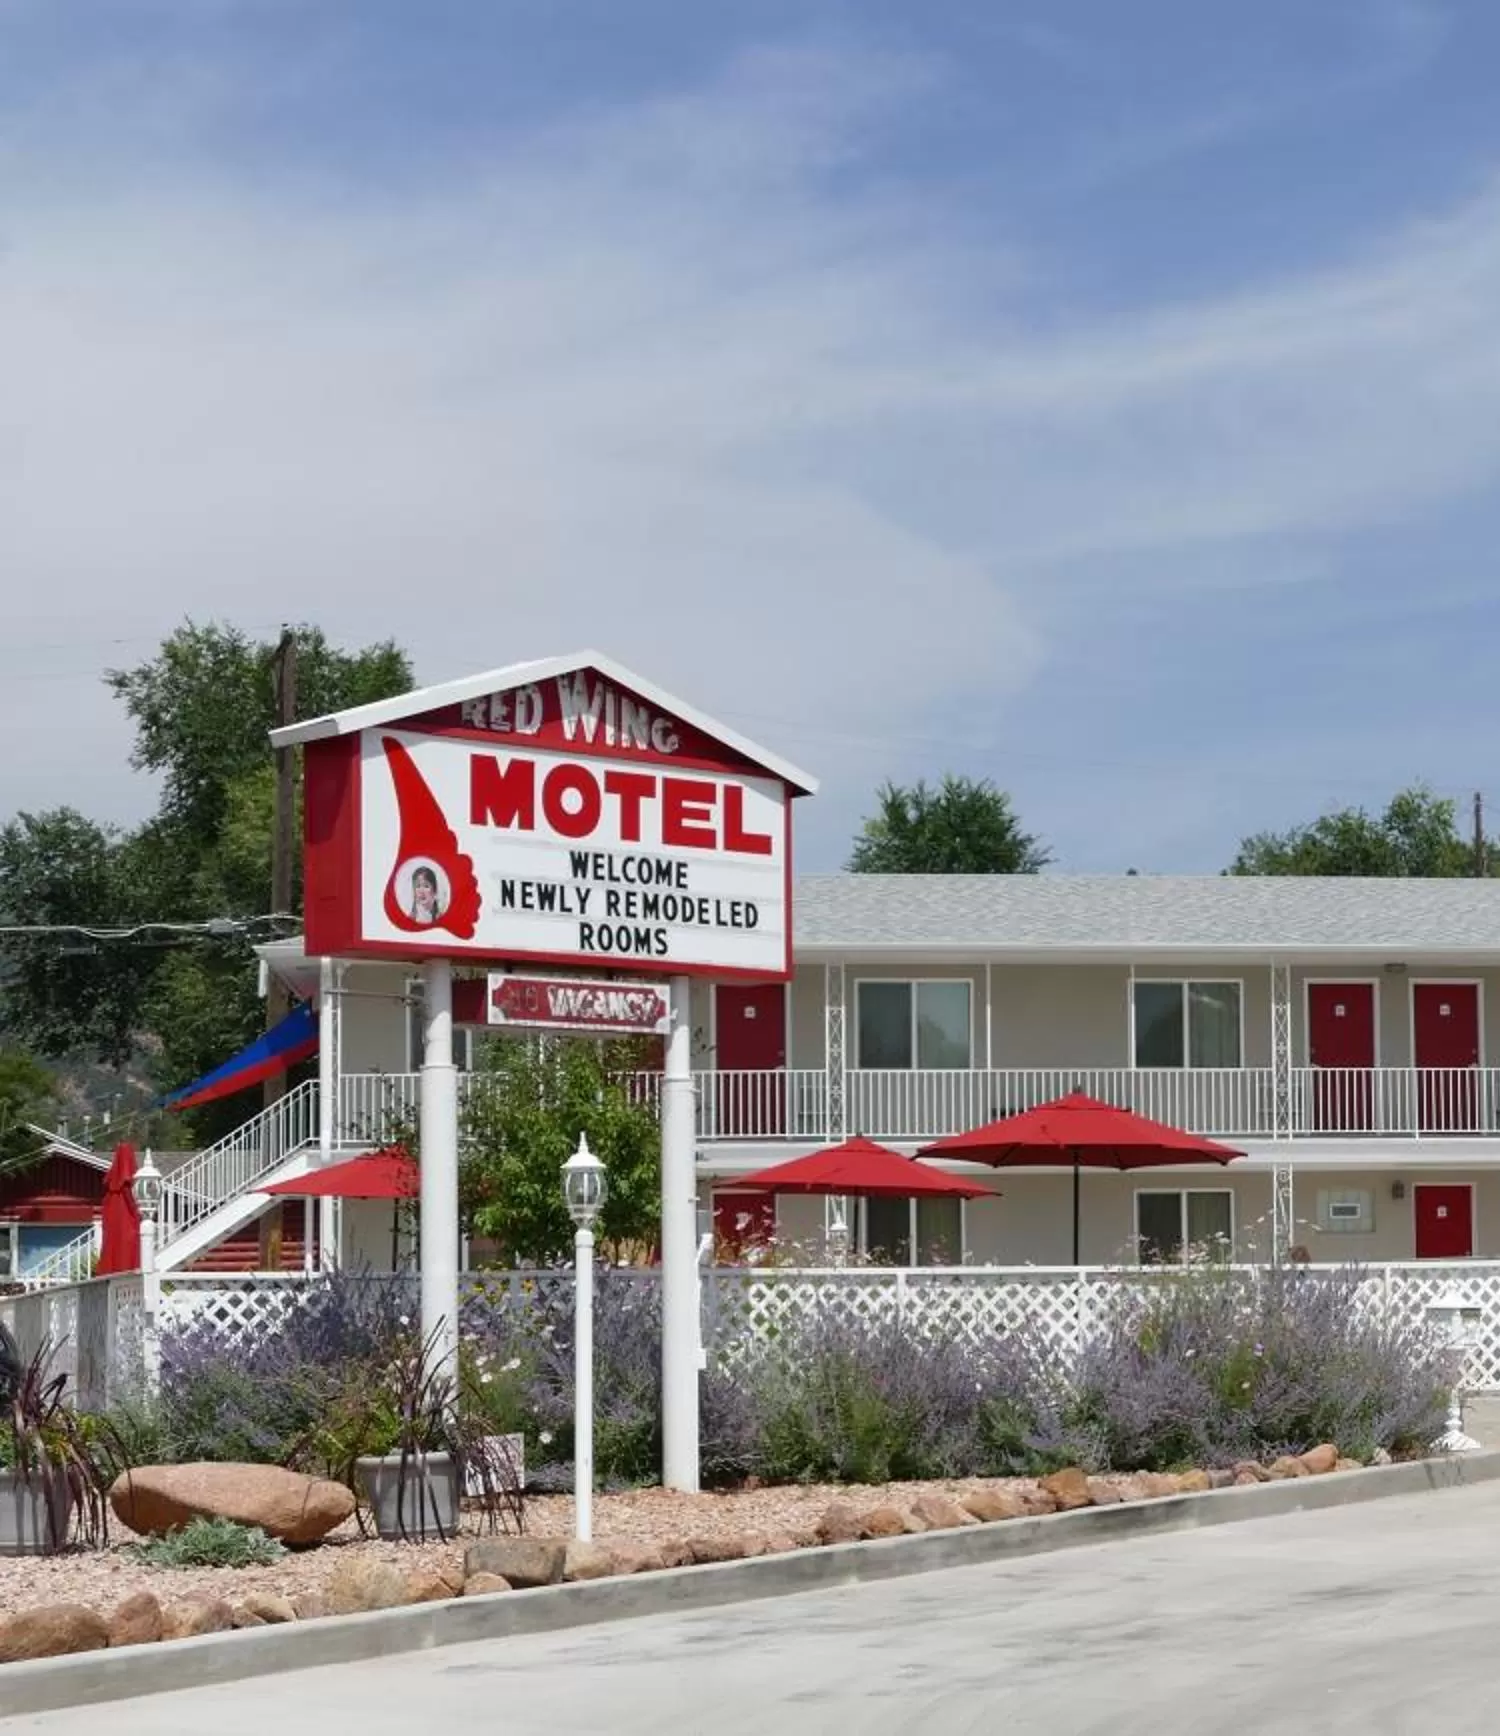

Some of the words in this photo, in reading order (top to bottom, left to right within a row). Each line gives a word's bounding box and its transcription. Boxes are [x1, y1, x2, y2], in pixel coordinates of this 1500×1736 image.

[462, 684, 543, 735] RED
[557, 670, 679, 753] WING
[470, 754, 772, 855] MOTEL
[570, 850, 689, 889] WELCOME
[501, 879, 591, 914] NEWLY
[606, 889, 758, 928] REMODELED
[579, 922, 668, 955] ROOMS
[547, 986, 656, 1022] VACANCY
